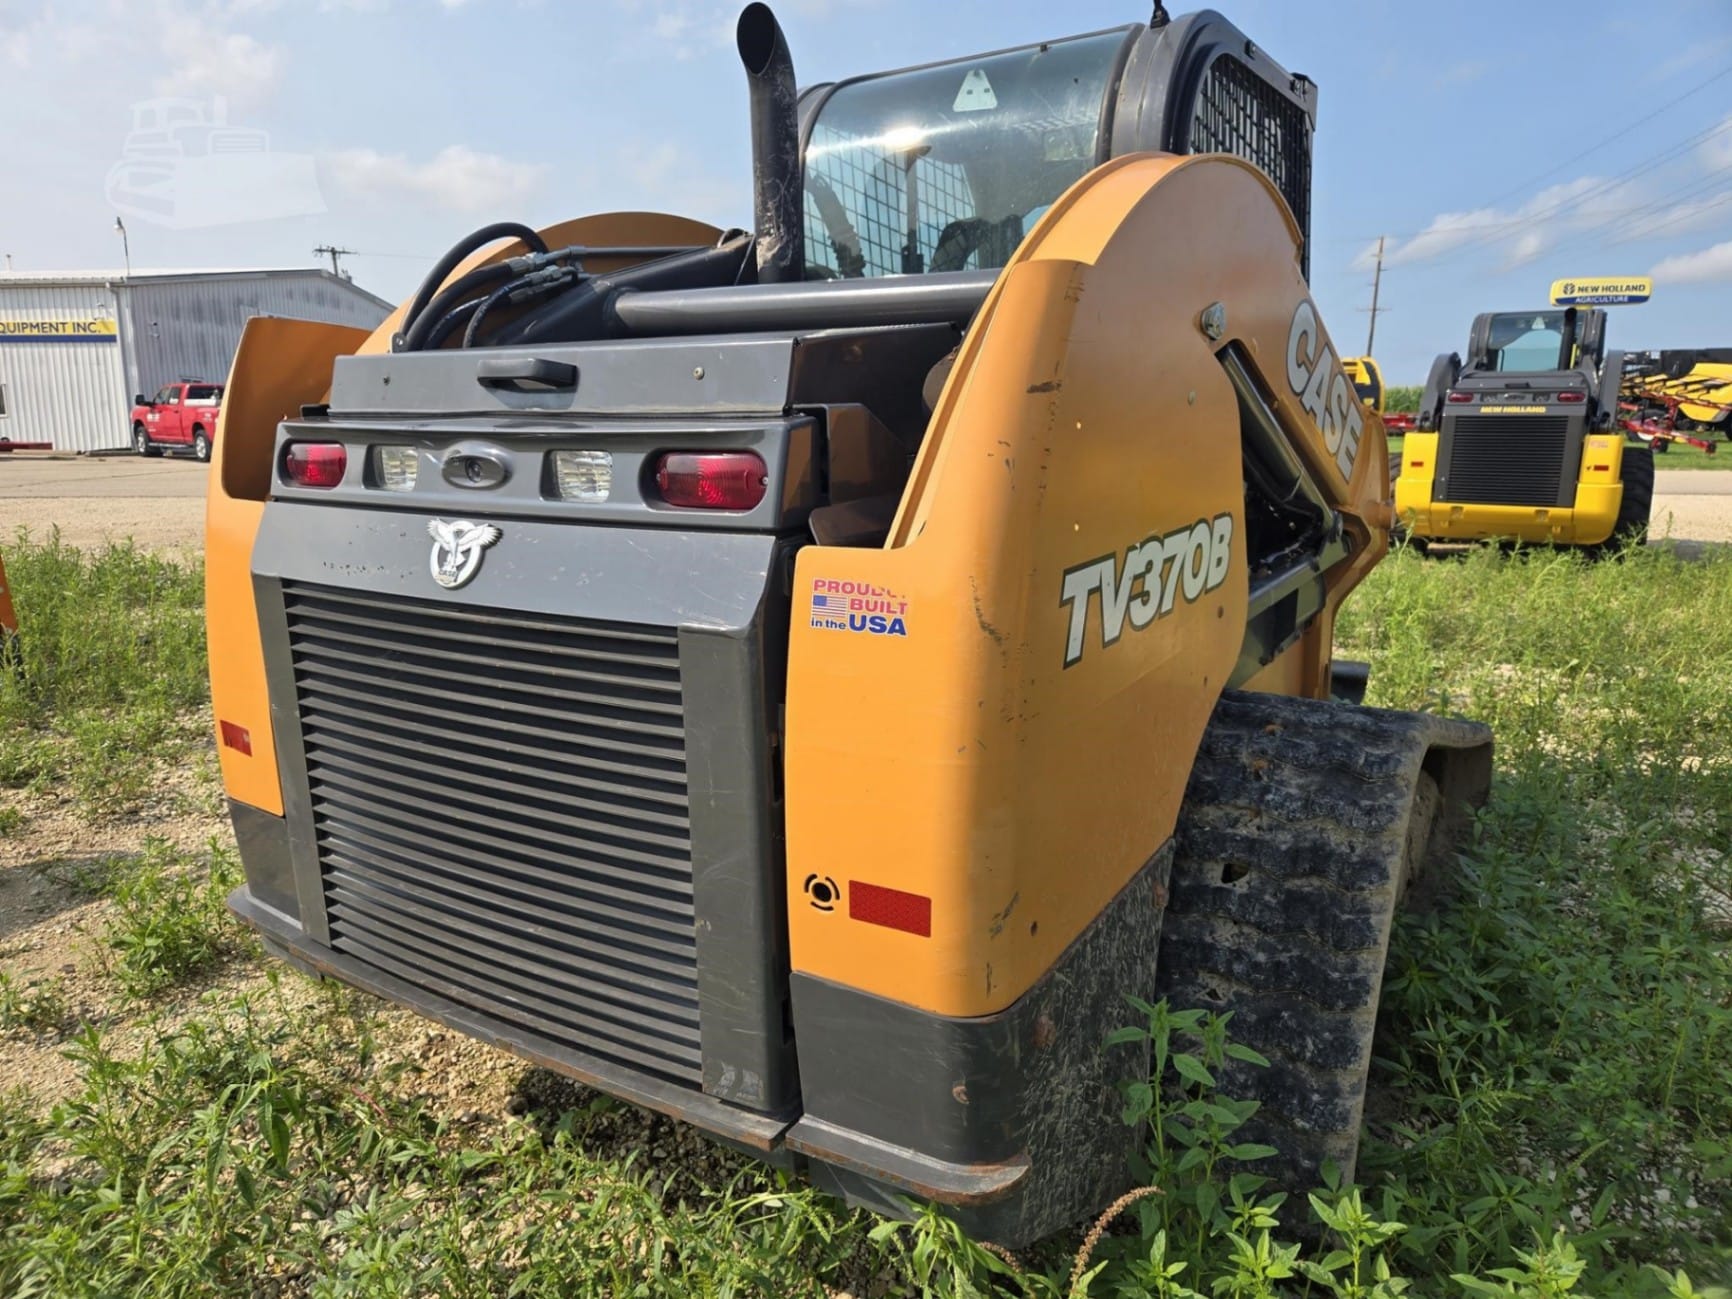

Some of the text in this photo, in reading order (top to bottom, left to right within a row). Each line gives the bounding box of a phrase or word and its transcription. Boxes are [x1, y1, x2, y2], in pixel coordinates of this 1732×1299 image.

[1601, 284, 1646, 293] HOLLAND
[1575, 295, 1628, 303] AGRICULTURE
[72, 322, 101, 333] INC.
[1286, 300, 1364, 485] CASE
[1059, 512, 1233, 670] TV370B
[850, 598, 907, 615] BUILT
[811, 613, 907, 636] in the USA
